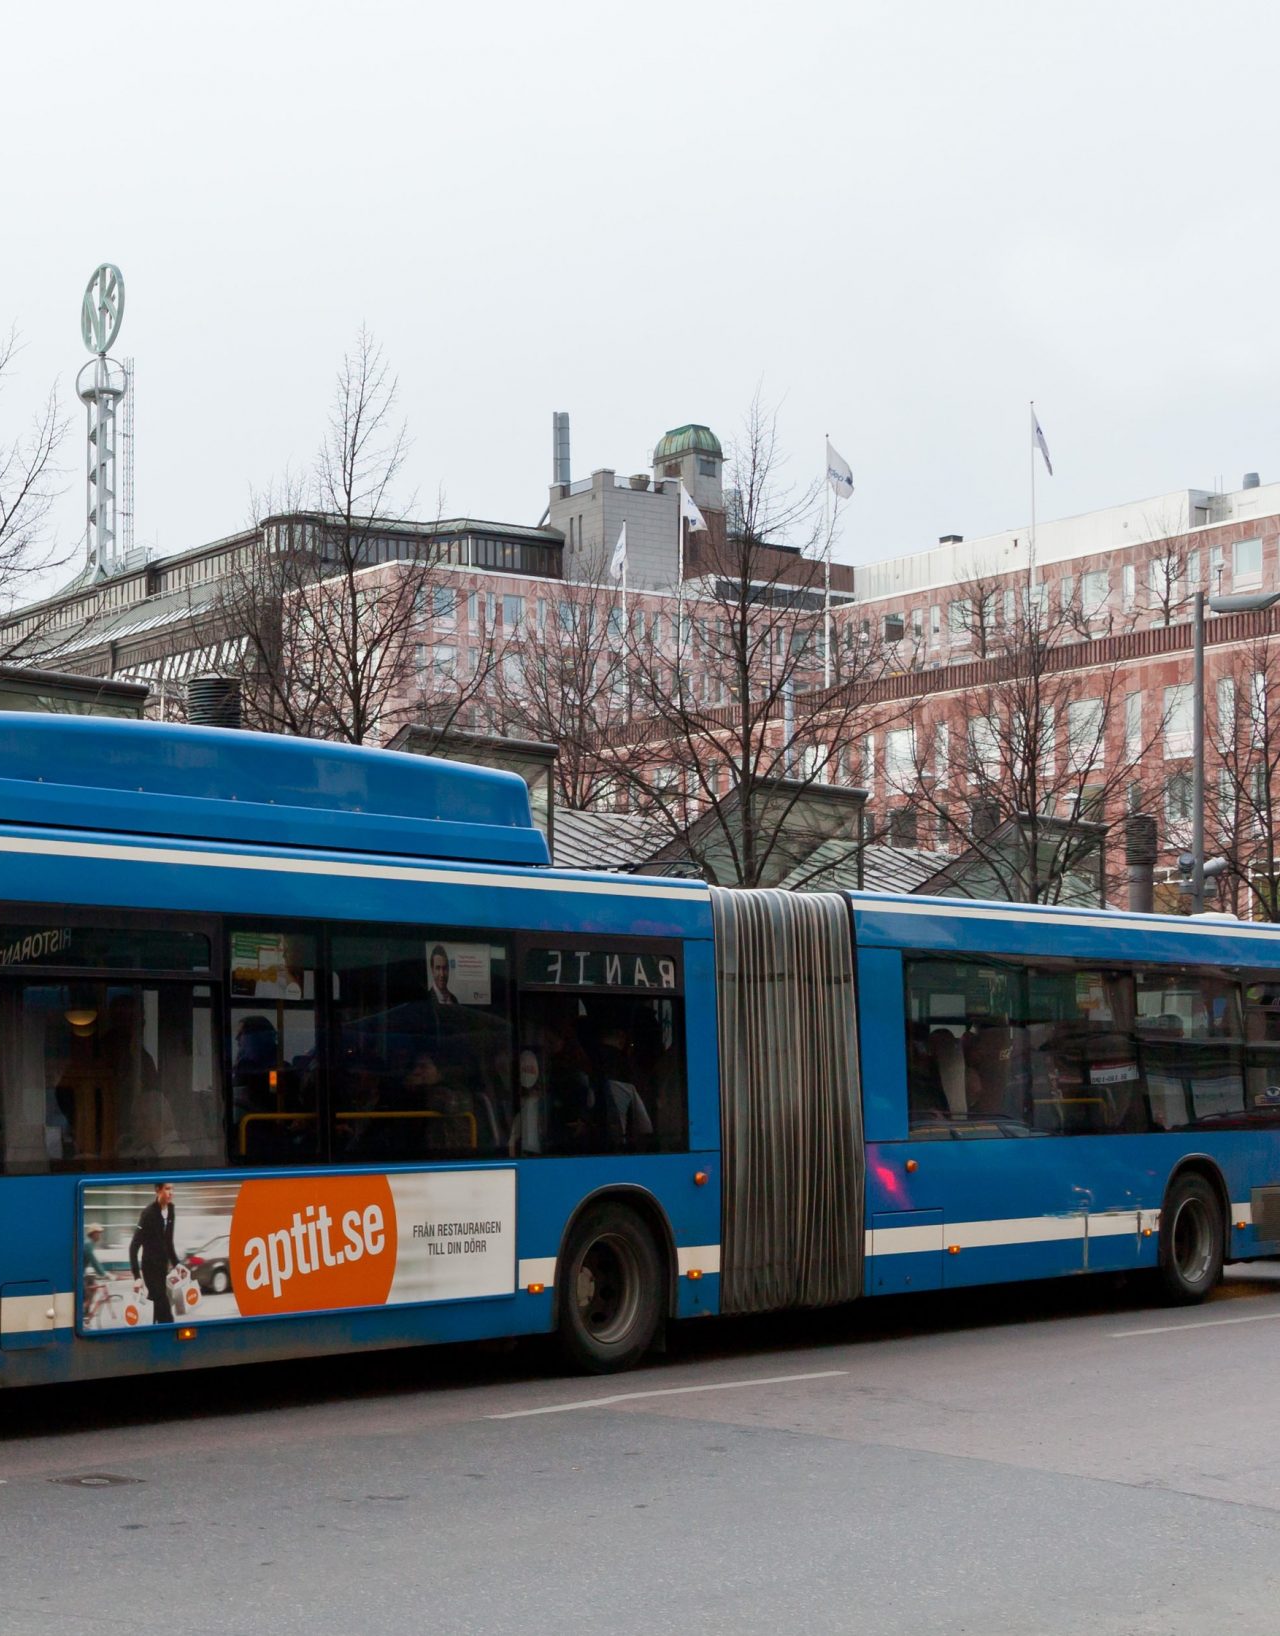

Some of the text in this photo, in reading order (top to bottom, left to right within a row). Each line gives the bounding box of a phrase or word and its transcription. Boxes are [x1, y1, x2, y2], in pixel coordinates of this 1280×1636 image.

[83, 264, 122, 352] NK
[243, 1204, 385, 1298] aptit.se
[413, 1221, 501, 1238] FRÅN RESTAURANGEN
[428, 1238, 487, 1256] TILL DIN DÖRR
